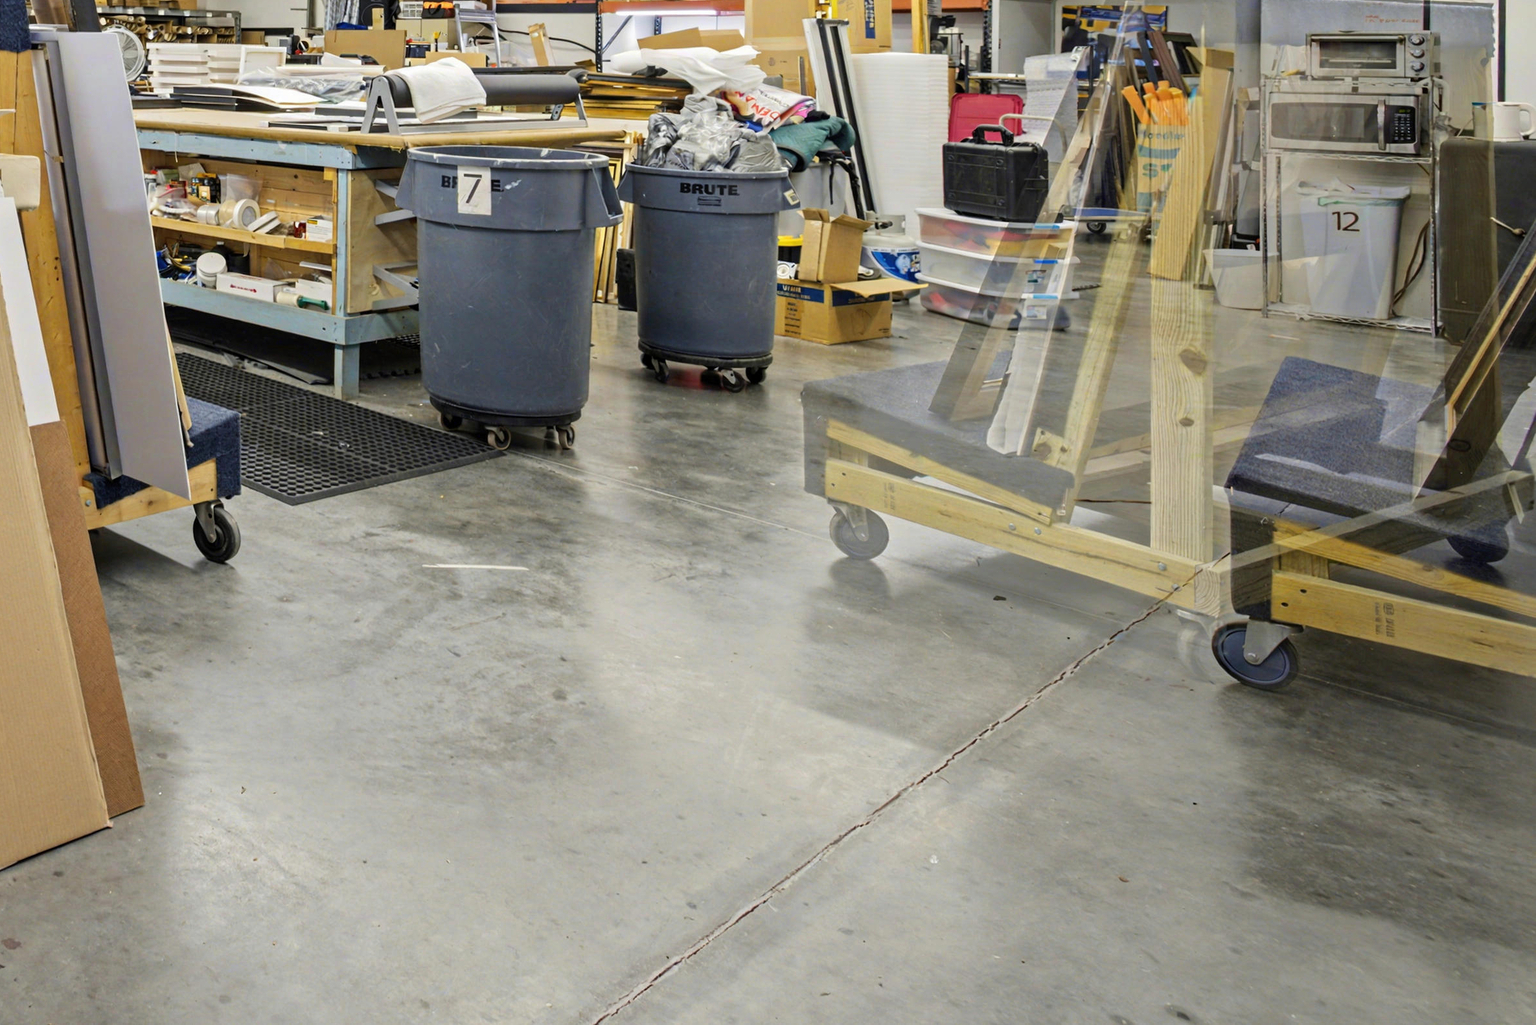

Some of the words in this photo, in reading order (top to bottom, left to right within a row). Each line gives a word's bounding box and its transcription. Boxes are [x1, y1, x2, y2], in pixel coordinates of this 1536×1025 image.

[463, 173, 483, 204] 7
[680, 182, 739, 196] BRUTE
[1331, 211, 1360, 232] 12
